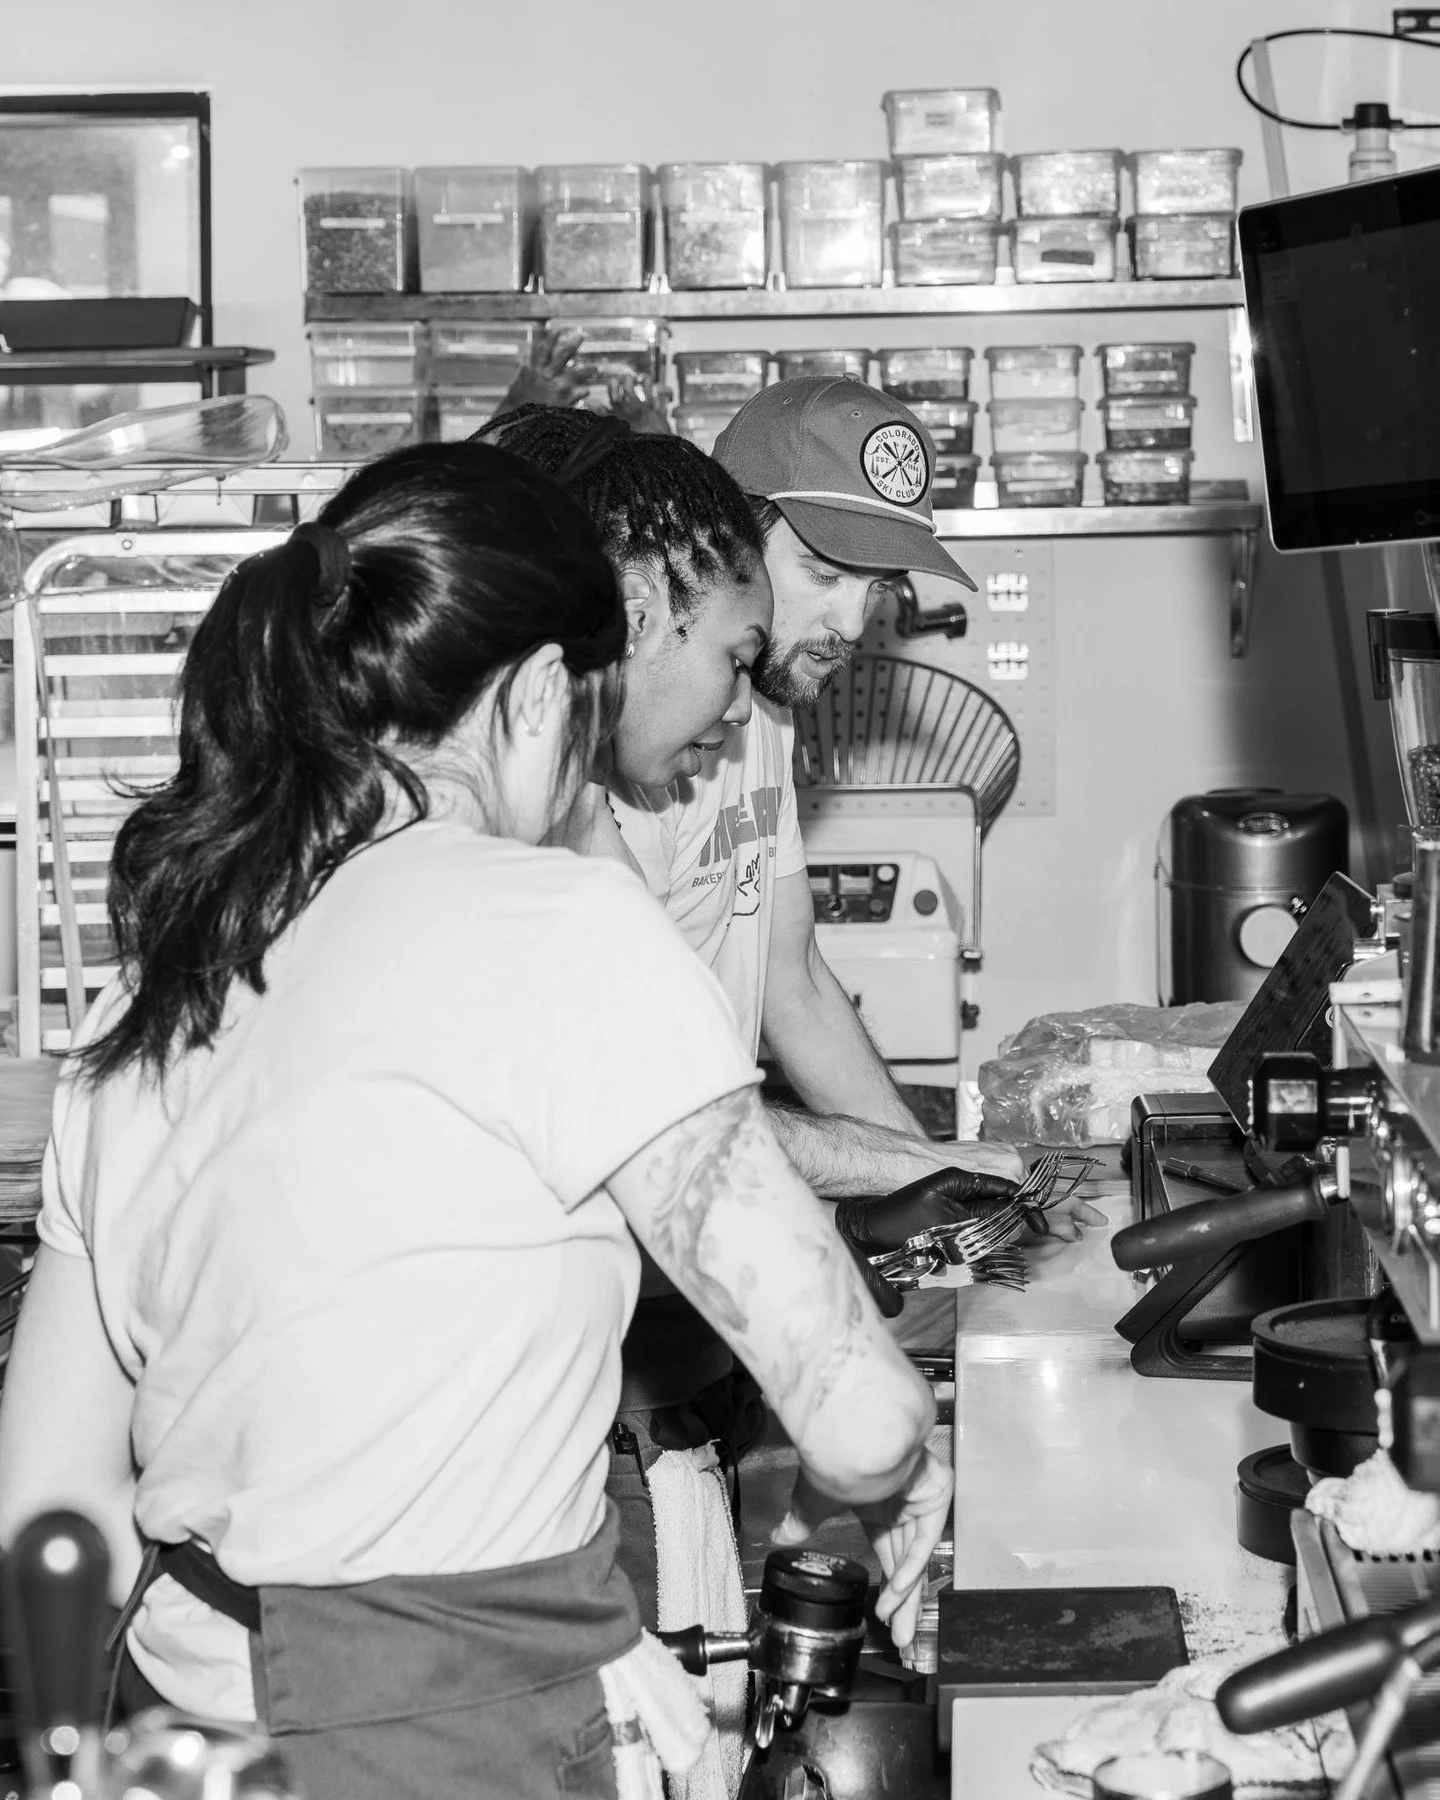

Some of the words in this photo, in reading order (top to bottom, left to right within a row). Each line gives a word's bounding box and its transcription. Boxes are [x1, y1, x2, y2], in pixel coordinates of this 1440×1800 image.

[876, 430, 919, 451] COLORADO
[877, 480, 892, 494] SKI
[896, 489, 915, 498] CLUB
[692, 872, 725, 888] BAKER
